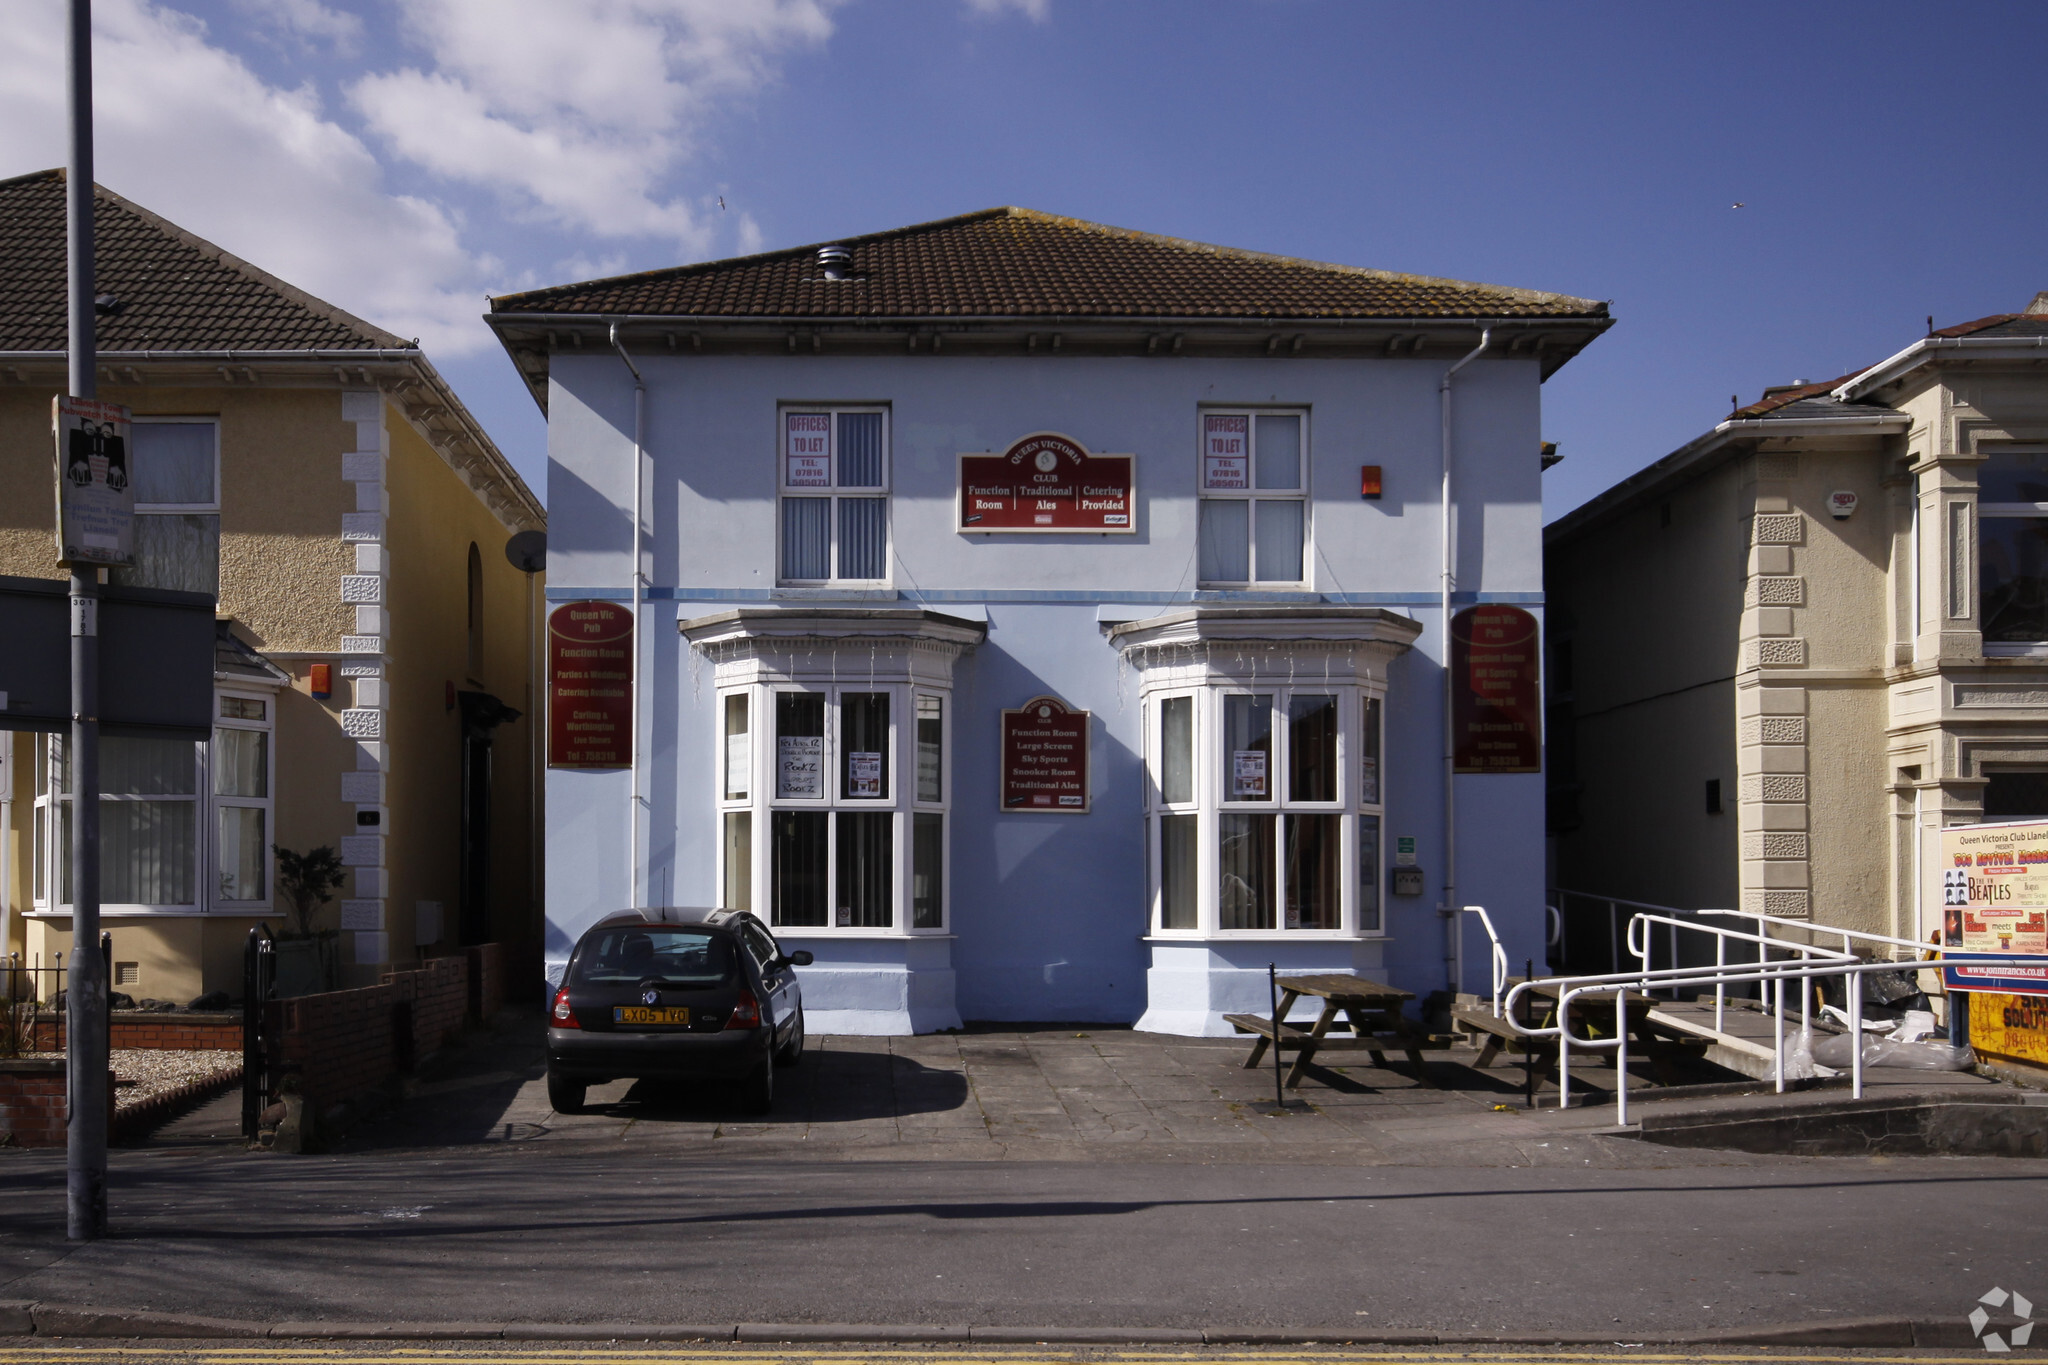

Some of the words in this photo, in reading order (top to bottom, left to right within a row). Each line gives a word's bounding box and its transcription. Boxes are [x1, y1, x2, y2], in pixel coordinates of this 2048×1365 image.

[103, 402, 123, 414] Town
[59, 405, 101, 419] Pubwatch
[103, 412, 132, 425] Scheme
[790, 416, 827, 431] OFFICES
[1207, 418, 1245, 433] OFFICES
[794, 437, 806, 452] TO
[808, 437, 824, 452] LET
[1211, 438, 1224, 453] TO
[1225, 439, 1241, 453] LET
[1011, 441, 1039, 465] QUEEN
[1041, 440, 1082, 465] VICTORIA
[801, 459, 818, 467] TEL:
[1033, 474, 1059, 483] CLUB
[968, 485, 1010, 496] Function
[1019, 484, 1073, 496] Traditional
[1083, 485, 1123, 498] Catering
[976, 499, 1003, 510] Room
[1036, 499, 1057, 510] Ales
[1082, 499, 1125, 510] Provided
[570, 610, 598, 621] Queen
[600, 610, 614, 620] Vic
[584, 623, 601, 632] Pub
[1485, 628, 1504, 638] Pub
[560, 648, 598, 657] Function
[599, 648, 624, 658] Room
[557, 670, 582, 679] Parties
[590, 671, 627, 680] Weddings
[558, 688, 589, 697] Catering
[590, 688, 625, 697] Available
[573, 711, 601, 720] Carling
[566, 722, 615, 732] Worthington
[1012, 729, 1051, 737] Function
[1052, 729, 1078, 737] Room
[574, 736, 588, 744] Live
[589, 736, 612, 744] Shows
[1017, 742, 1042, 751] Large
[1043, 742, 1073, 750] Screen
[1022, 755, 1038, 764] Sky
[1040, 755, 1068, 764] Sports
[1013, 768, 1049, 776] Snooker
[1051, 768, 1076, 776] Room
[1009, 781, 1059, 789] Traditional
[1959, 836, 1981, 845] Queen
[1981, 833, 2009, 844] Victoria
[2009, 832, 2026, 842] Club
[1968, 877, 2011, 905] BEATLES
[622, 1009, 656, 1022] LX05
